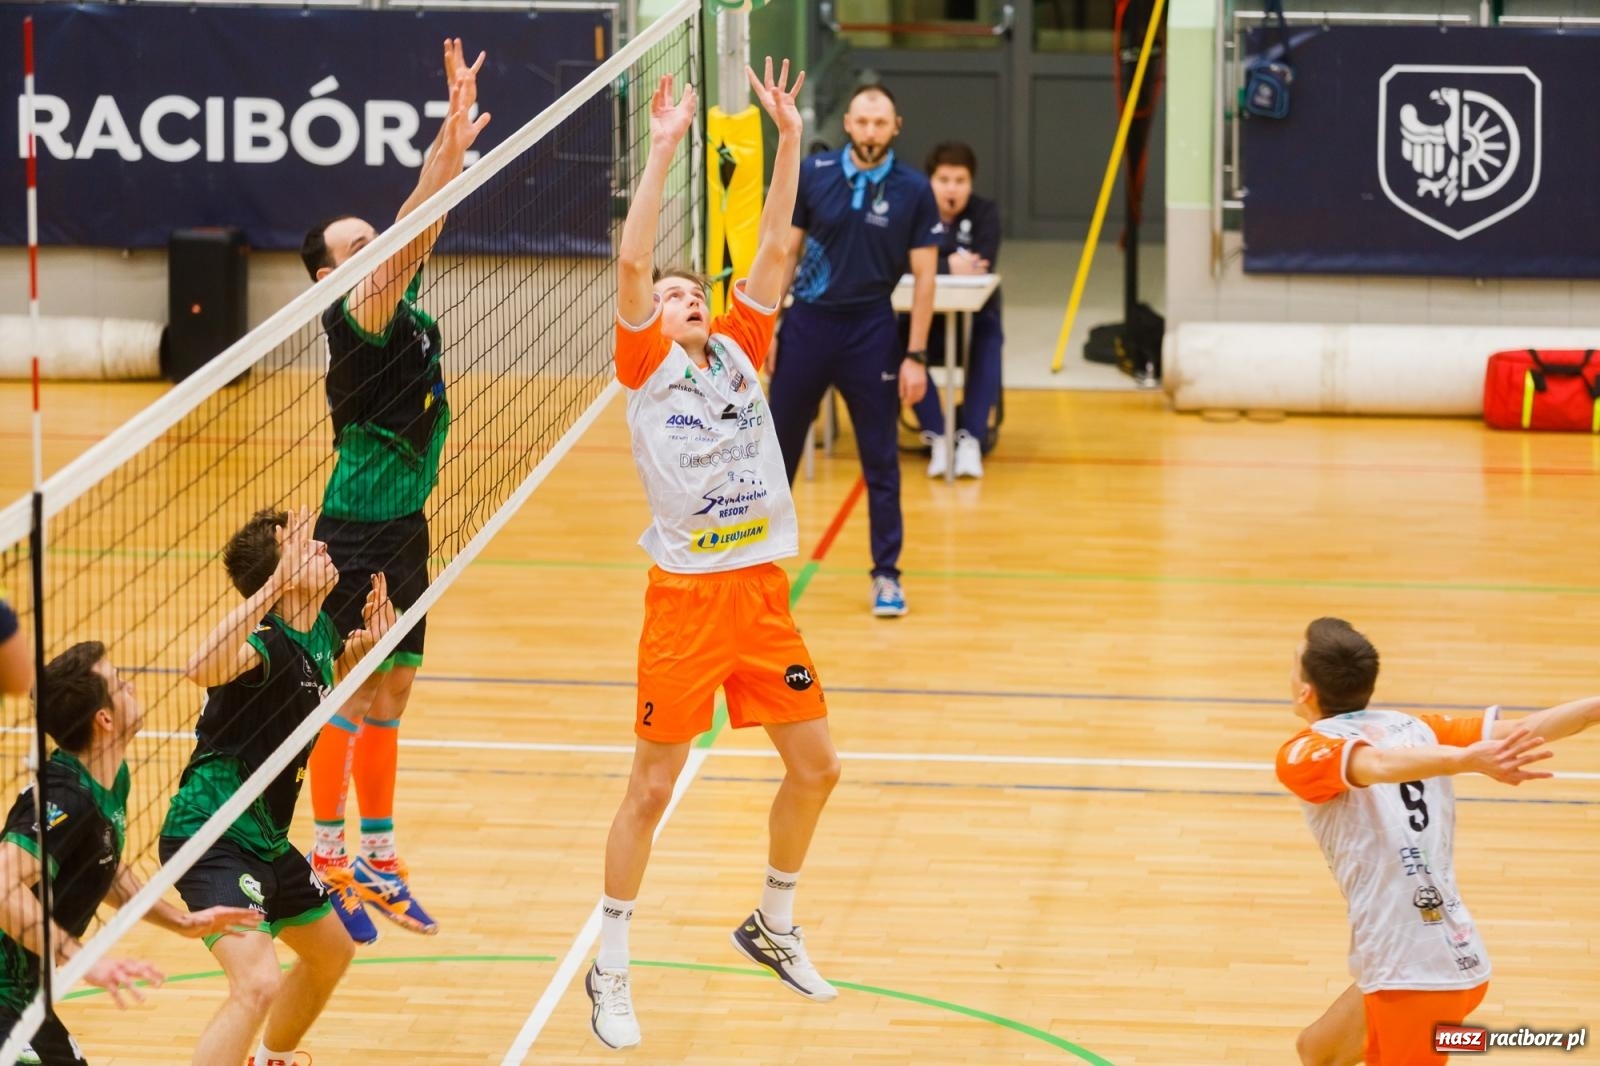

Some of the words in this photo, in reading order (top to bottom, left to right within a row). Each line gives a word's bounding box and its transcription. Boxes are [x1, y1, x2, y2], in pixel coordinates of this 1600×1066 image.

[719, 506, 749, 519] RESORT
[643, 702, 654, 726] 2
[1399, 780, 1429, 832] 9
